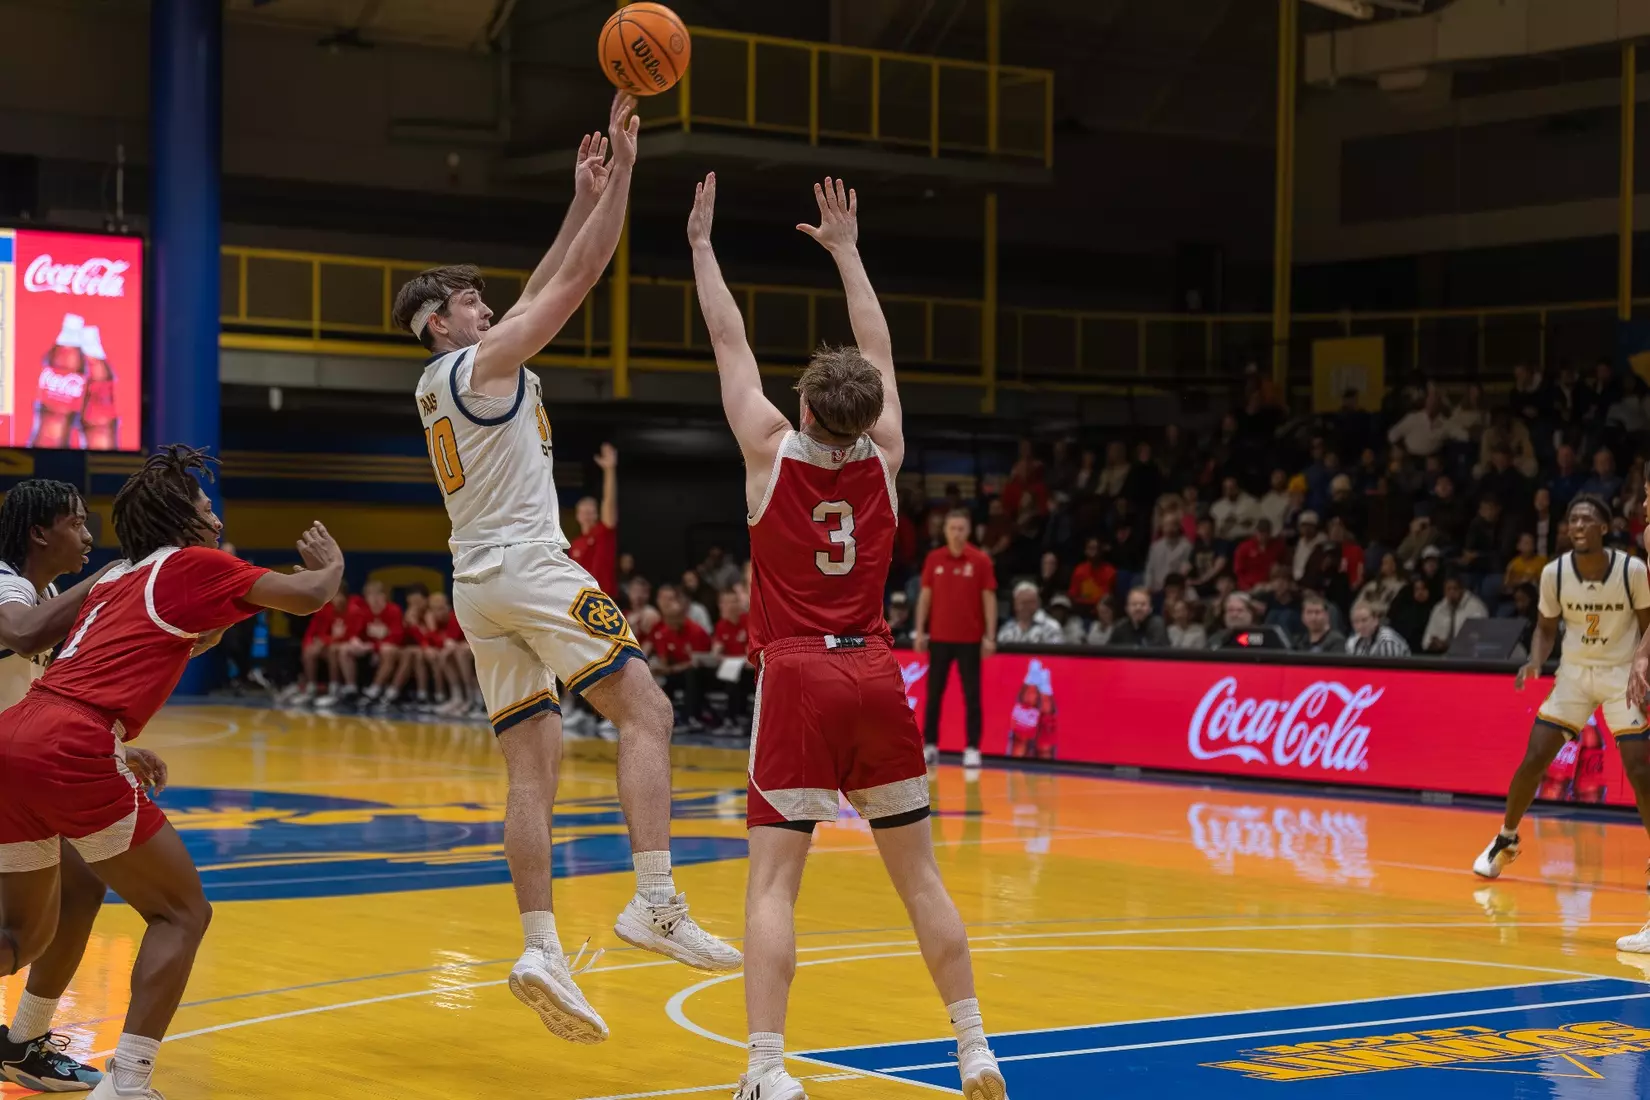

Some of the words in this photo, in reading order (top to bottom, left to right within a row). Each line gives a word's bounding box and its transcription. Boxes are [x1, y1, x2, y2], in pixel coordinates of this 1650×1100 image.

[631, 36, 668, 88] Wilson
[24, 254, 129, 297] Coca-Cola
[812, 500, 857, 576] 3
[1566, 602, 1625, 612] KANSAS
[1581, 636, 1609, 645] CITY
[1585, 614, 1600, 637] 2
[1188, 676, 1386, 772] Coca-Cola
[1252, 1025, 1498, 1055] LEAGUE
